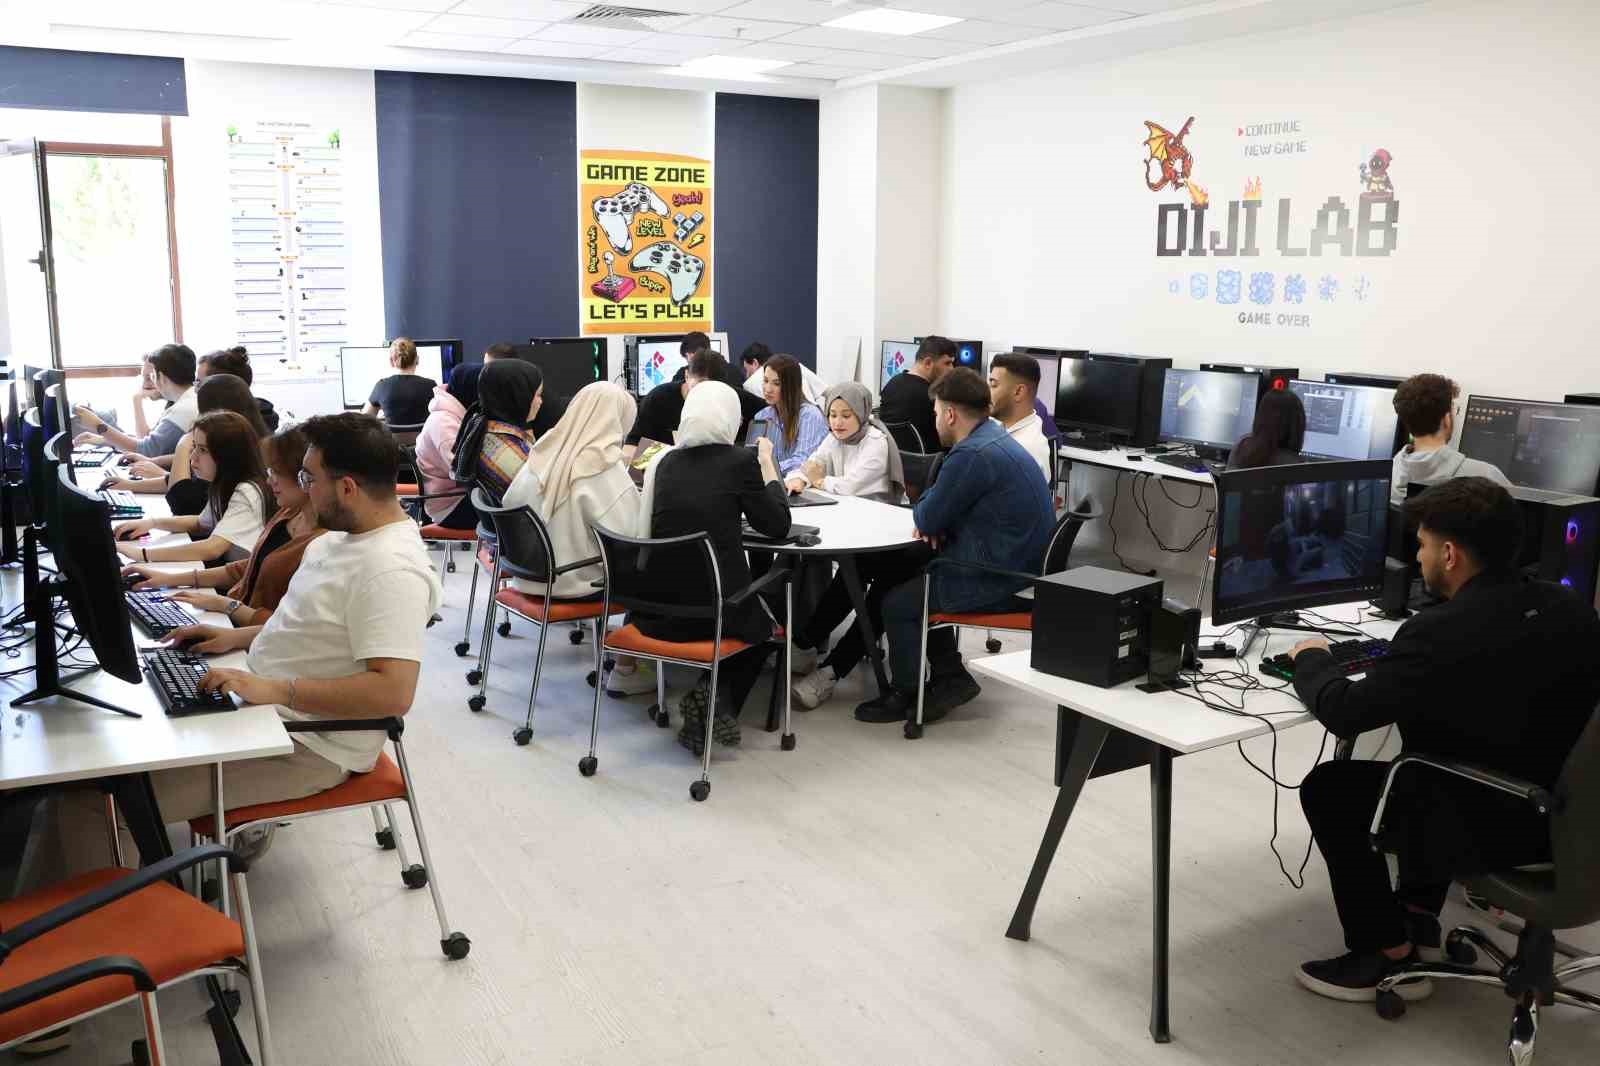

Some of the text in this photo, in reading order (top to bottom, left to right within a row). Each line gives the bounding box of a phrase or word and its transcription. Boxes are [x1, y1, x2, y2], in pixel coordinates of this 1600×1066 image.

[1245, 120, 1301, 137] CONTINUE
[1244, 140, 1307, 157] NEW GAME
[587, 164, 705, 183] GAME ZONE
[1156, 195, 1400, 257] DIJI LAB
[590, 303, 704, 319] LET'S PLAY
[1238, 312, 1311, 327] GAME OVER
